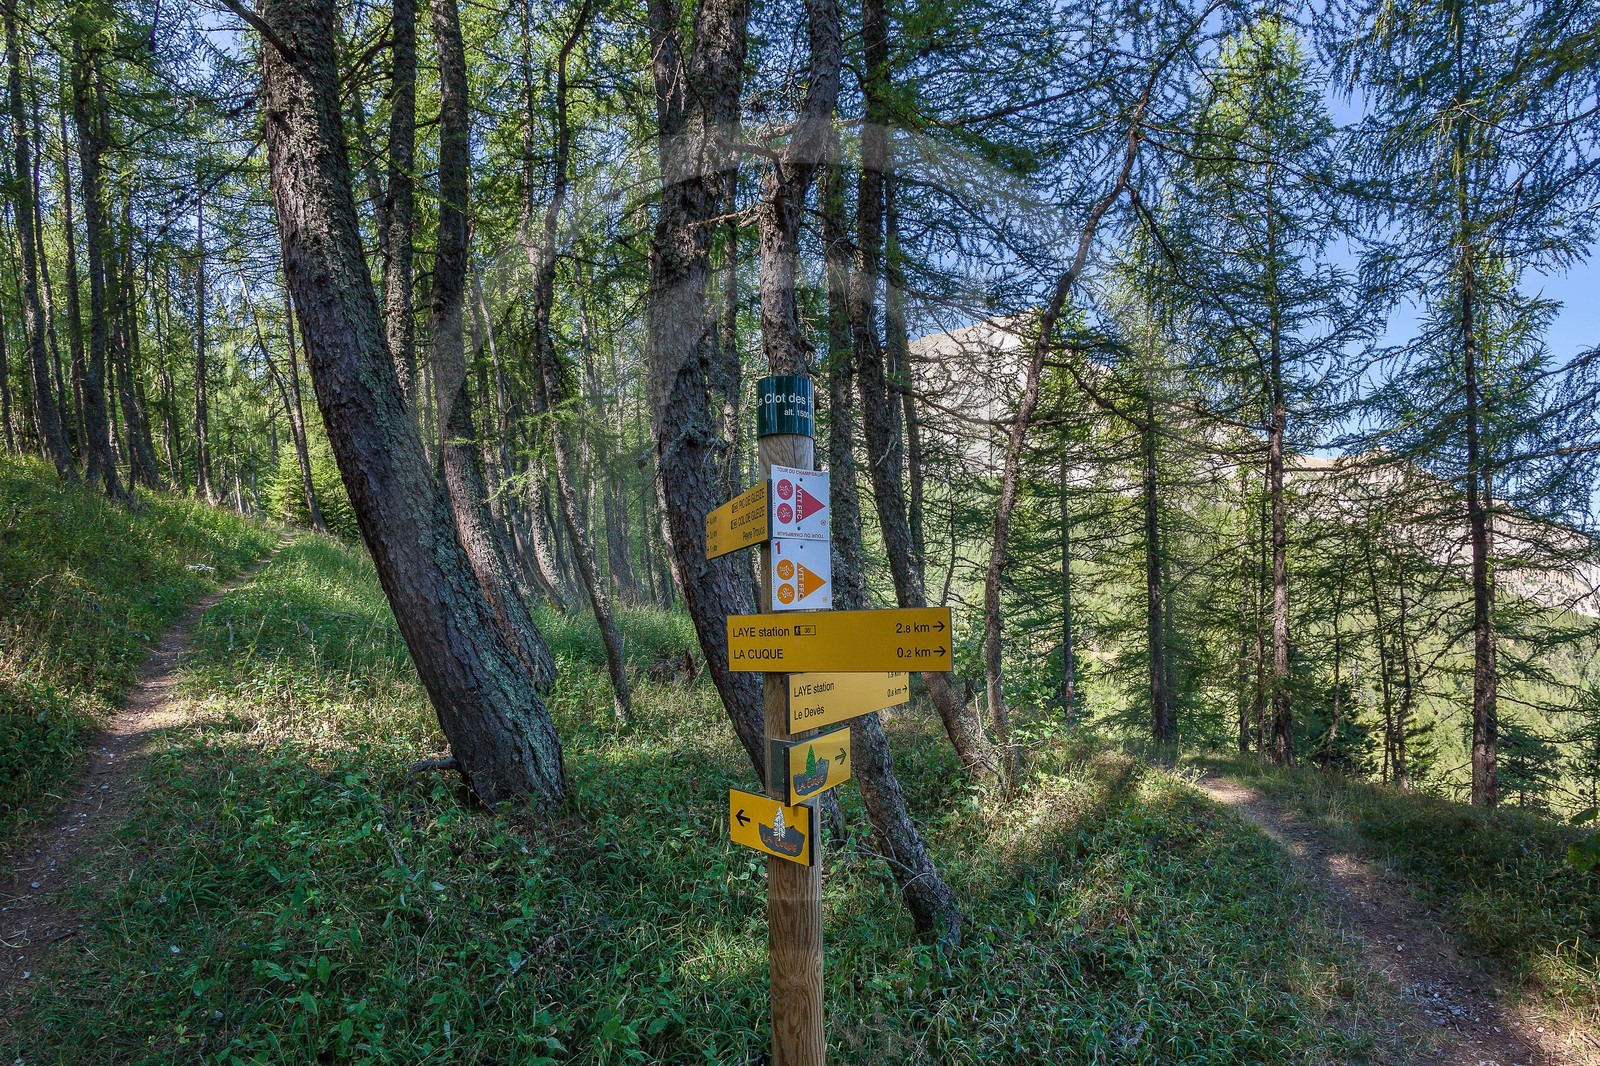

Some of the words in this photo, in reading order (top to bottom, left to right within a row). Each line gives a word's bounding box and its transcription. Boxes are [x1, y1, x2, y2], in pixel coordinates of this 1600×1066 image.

[764, 392, 786, 404] Clot
[788, 392, 807, 405] des
[774, 540, 781, 555] 1
[732, 626, 757, 638] LAYE
[758, 626, 790, 637] station
[895, 622, 911, 634] 2.8
[913, 622, 930, 633] km
[733, 649, 746, 660] LA
[747, 648, 784, 660] CUQUE
[896, 646, 912, 658] 0.2
[914, 646, 931, 658] km
[793, 684, 812, 698] LAYE
[813, 682, 835, 694] station
[793, 709, 803, 721] Le
[804, 704, 825, 719] Devès
[797, 782, 806, 793] LA
[763, 834, 773, 844] LA
